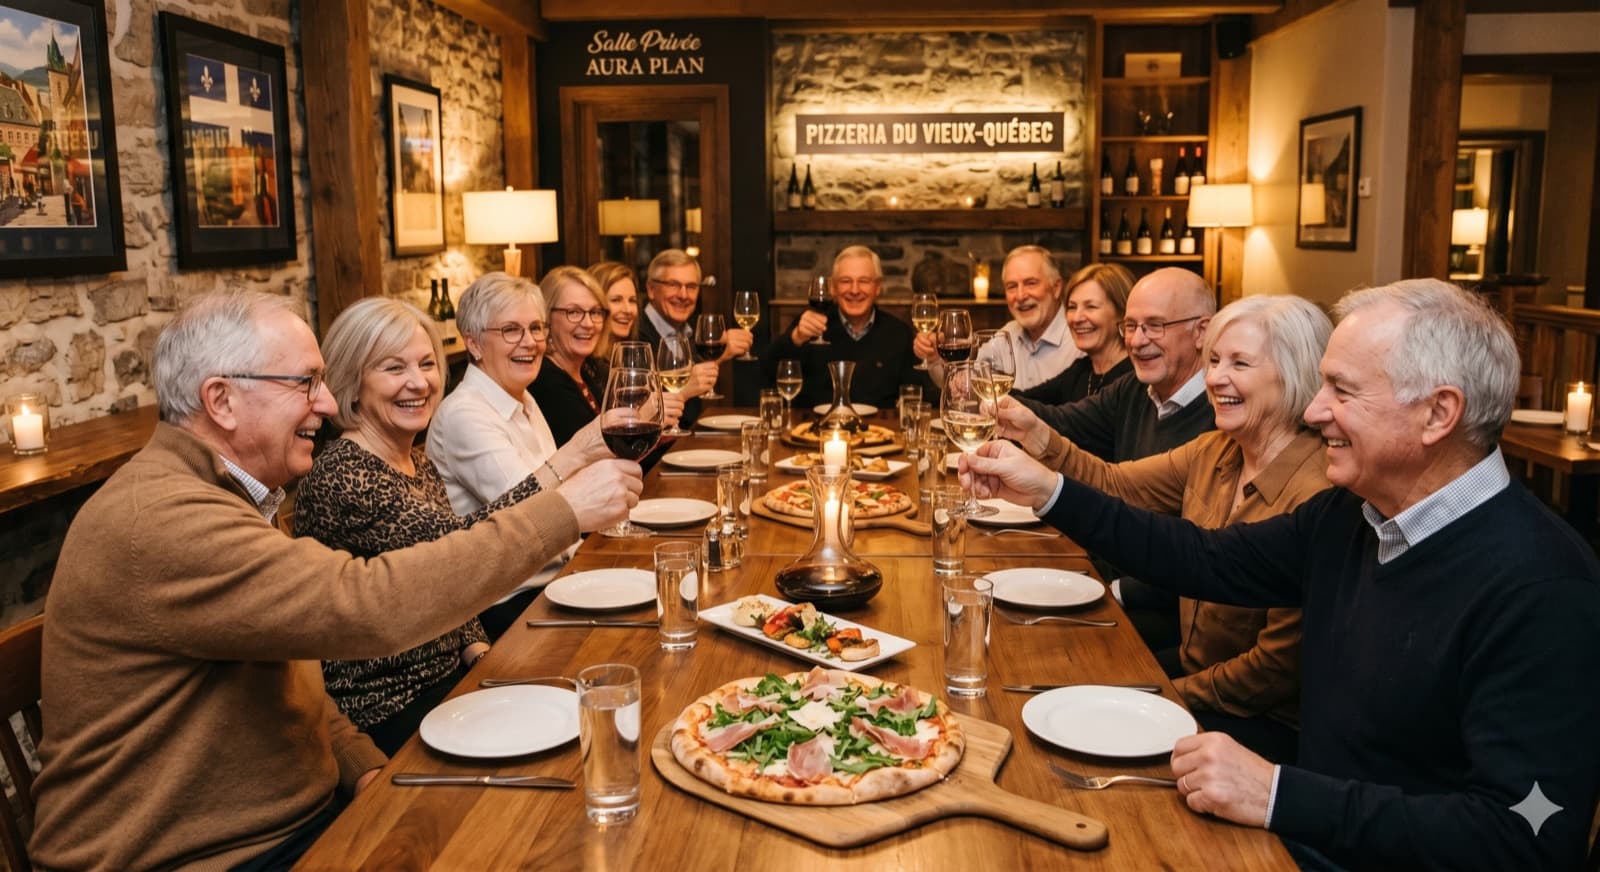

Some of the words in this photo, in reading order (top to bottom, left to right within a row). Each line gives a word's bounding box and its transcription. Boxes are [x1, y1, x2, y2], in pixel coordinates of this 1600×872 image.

[587, 29, 638, 54] Salle
[640, 29, 702, 53] Privée
[586, 58, 645, 76] AURA
[649, 57, 705, 75] PLAN
[805, 123, 888, 145] PIZZERIA
[892, 122, 918, 145] DU
[922, 117, 1054, 147] VIEUX-QUÉBEC
